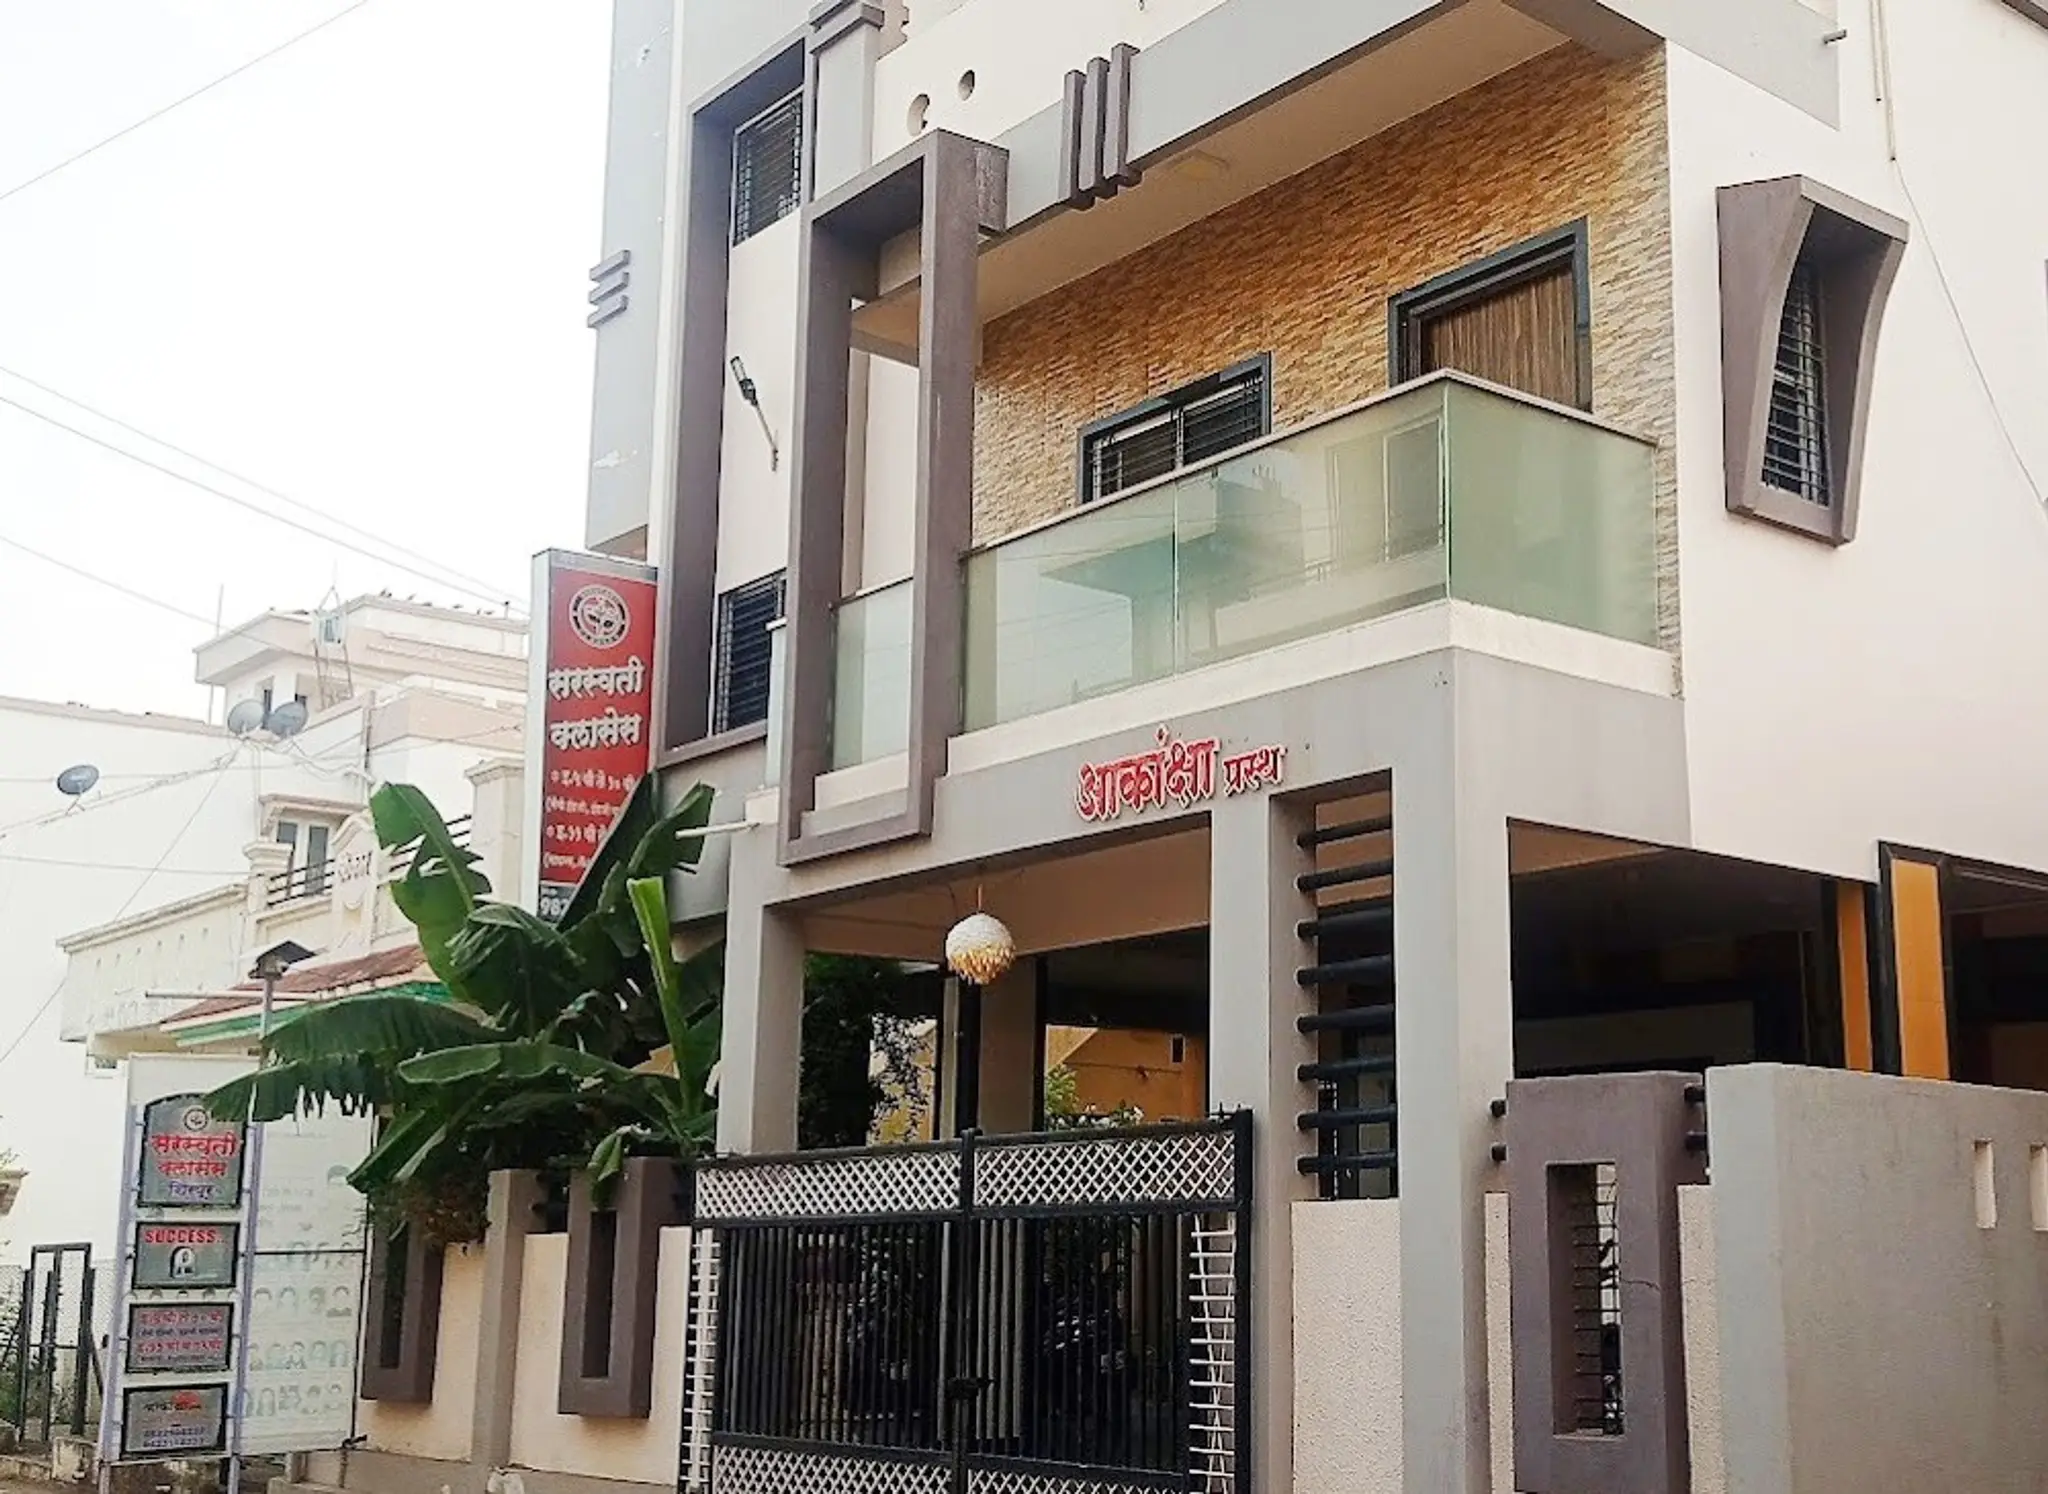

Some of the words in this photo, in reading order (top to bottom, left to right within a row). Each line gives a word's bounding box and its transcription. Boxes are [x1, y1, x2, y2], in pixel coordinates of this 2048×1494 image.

[548, 655, 645, 701] सरस्वती
[549, 706, 642, 750] क्लासेस
[1076, 723, 1220, 821] आकांक्षा
[1221, 744, 1286, 797] प्रस्थ
[152, 1131, 237, 1156] सरस्वती
